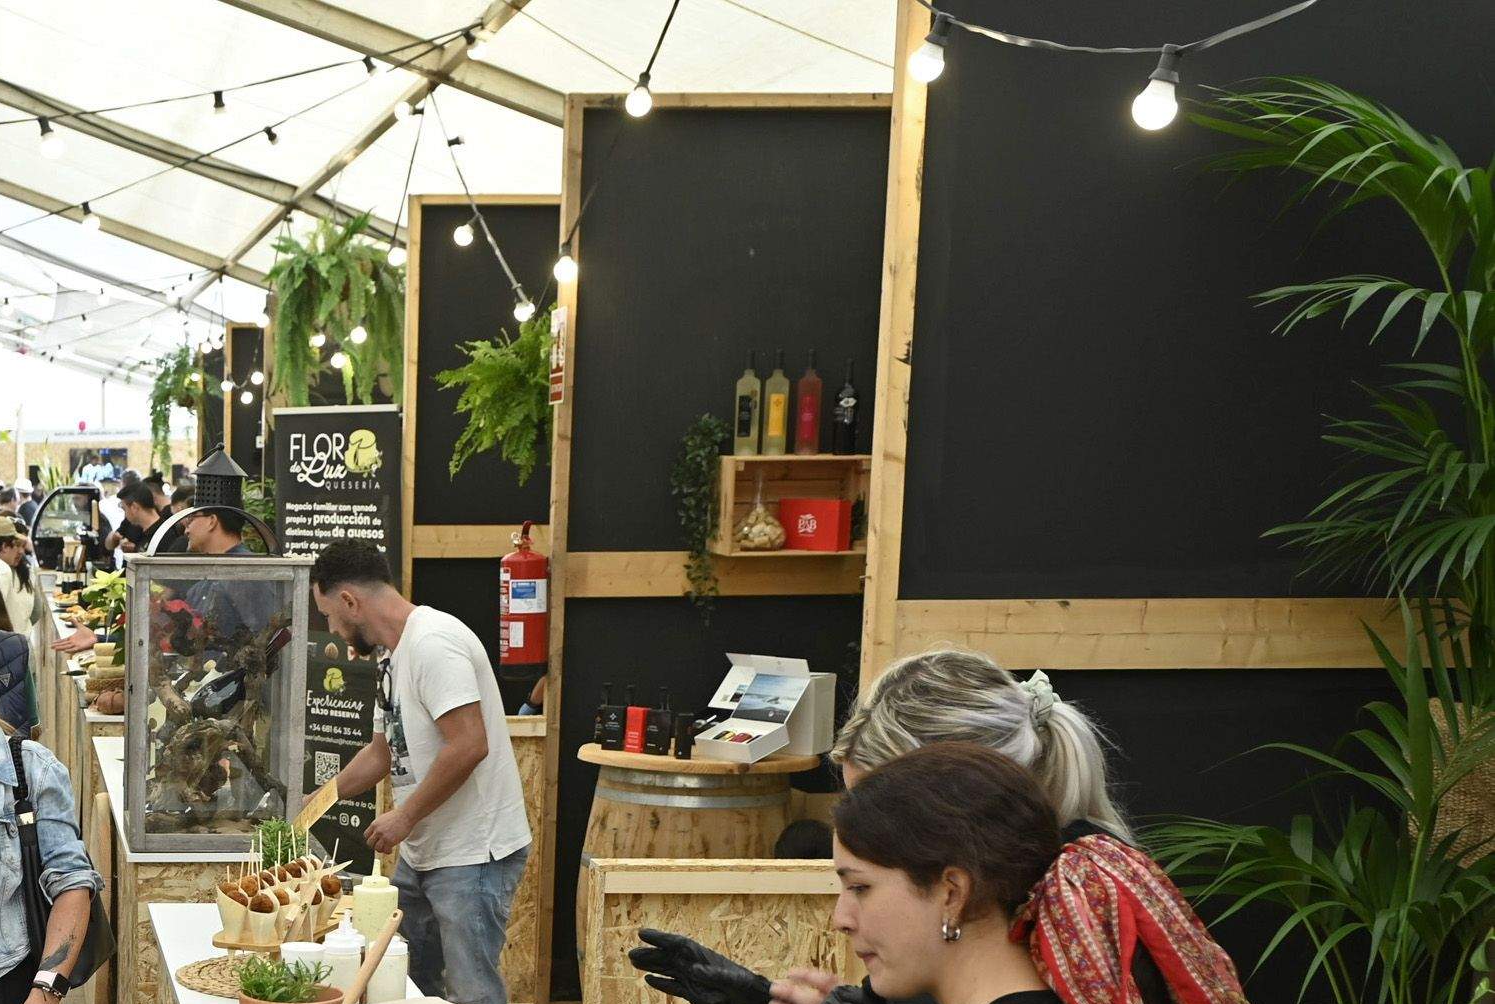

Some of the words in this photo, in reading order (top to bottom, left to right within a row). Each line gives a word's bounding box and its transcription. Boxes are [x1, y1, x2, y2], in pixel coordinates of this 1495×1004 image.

[290, 432, 345, 461] FLOR
[290, 461, 302, 473] de
[296, 451, 348, 488] Luz
[325, 480, 380, 491] QUESERÍA
[286, 502, 312, 512] Negocio
[313, 502, 338, 511] familiar
[352, 504, 377, 513] ganado
[286, 515, 306, 524] propio
[307, 516, 312, 525] y
[313, 512, 370, 526] producción
[372, 517, 382, 526] de
[285, 527, 314, 536] distintos
[314, 528, 331, 538] tipos
[332, 526, 345, 537] de
[290, 541, 309, 550] partir
[309, 542, 319, 550] de
[306, 690, 364, 711] Experiencias
[311, 708, 329, 716] BAJO
[330, 710, 360, 719] RESERVA
[309, 723, 321, 731] +34
[333, 726, 342, 734] 64
